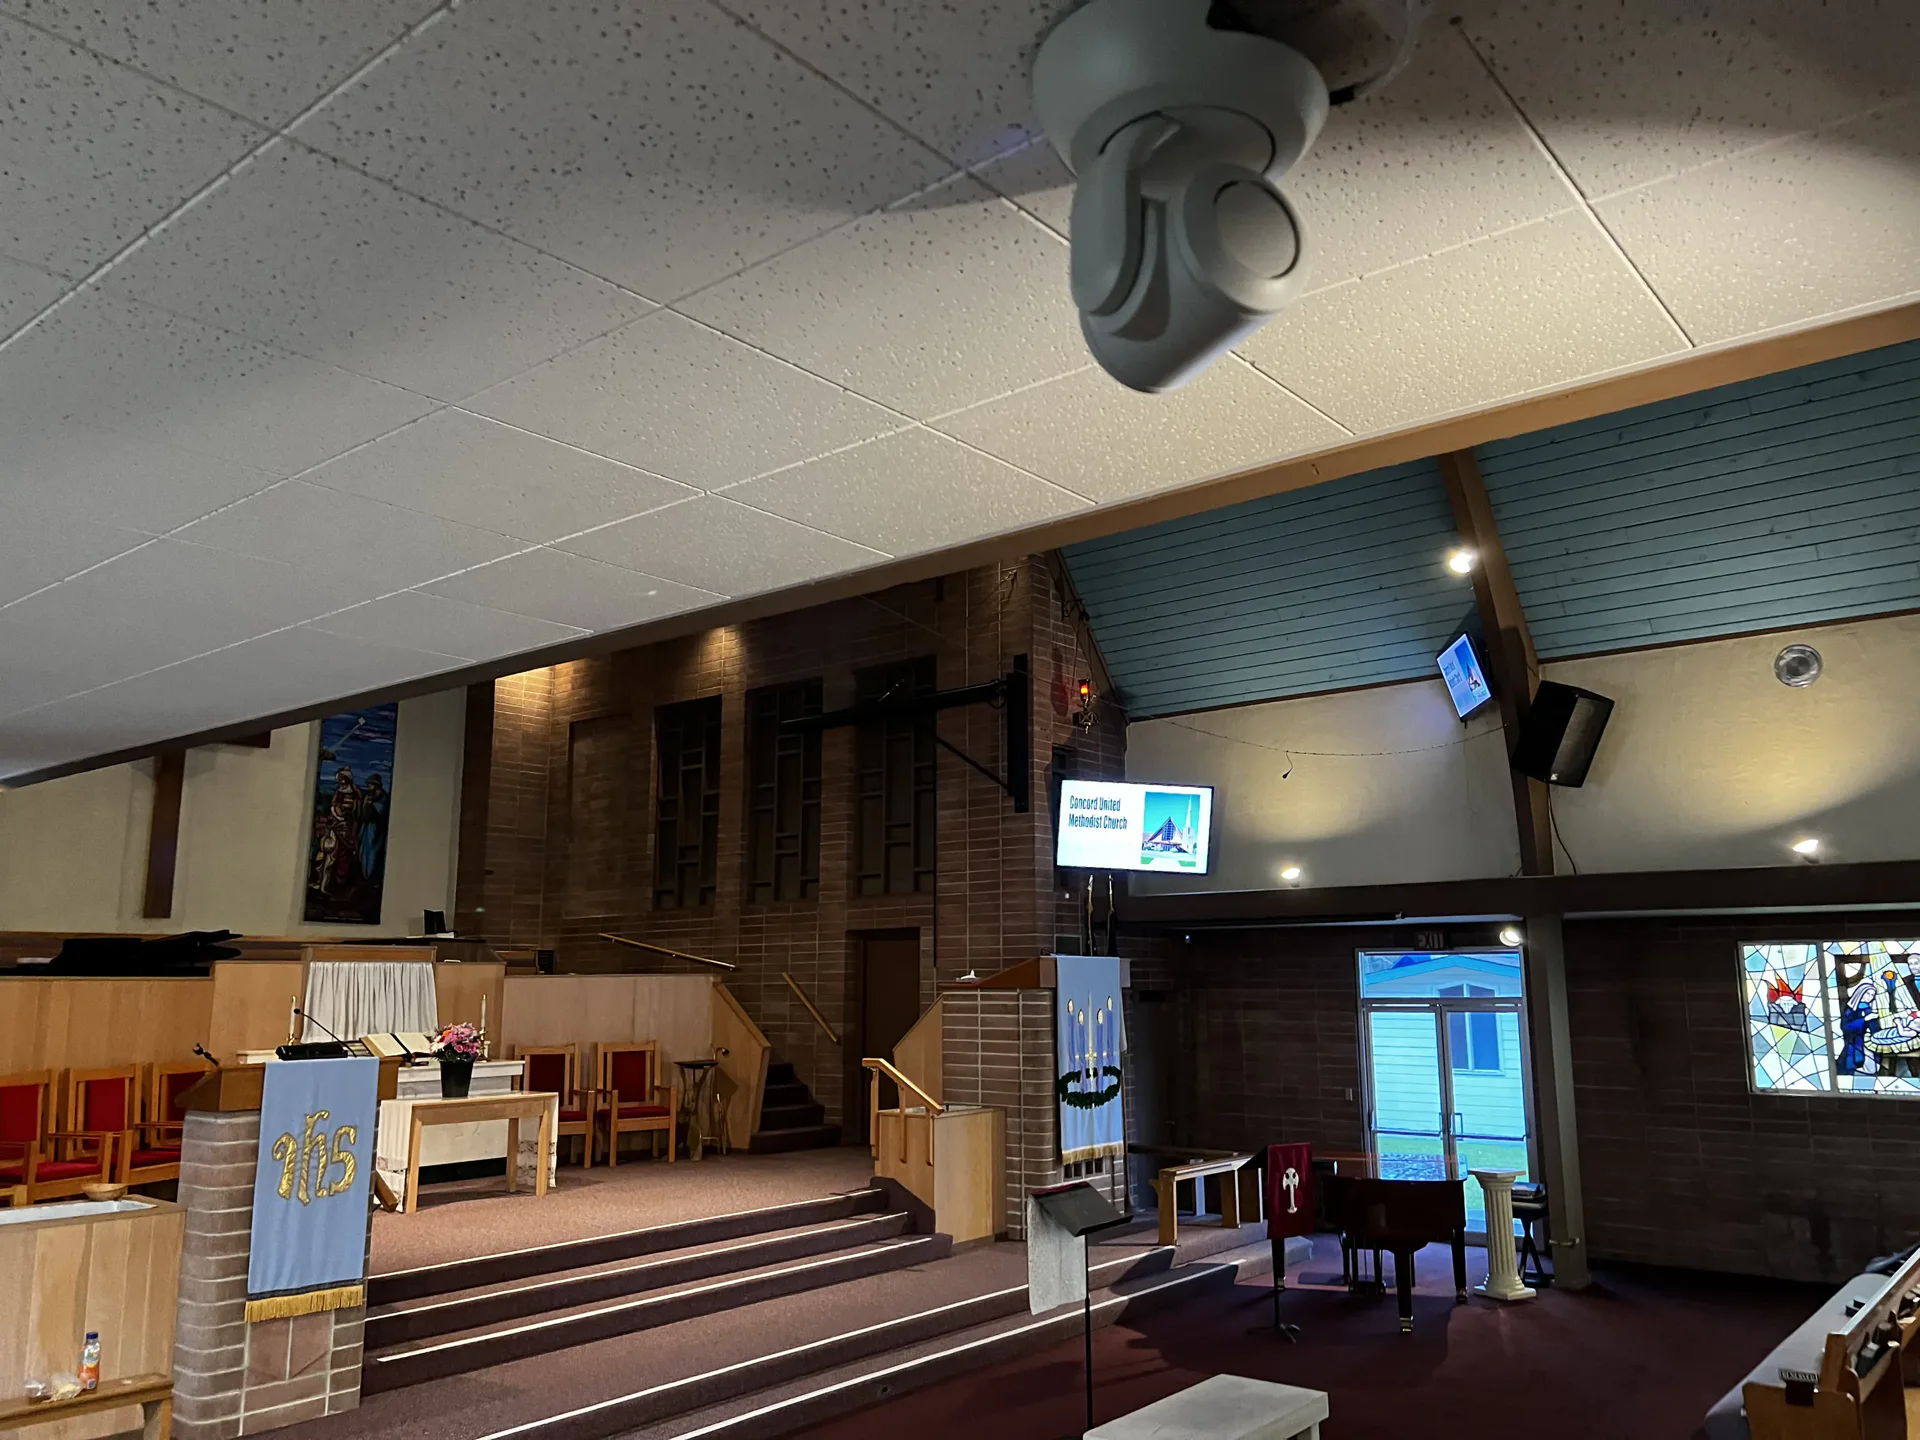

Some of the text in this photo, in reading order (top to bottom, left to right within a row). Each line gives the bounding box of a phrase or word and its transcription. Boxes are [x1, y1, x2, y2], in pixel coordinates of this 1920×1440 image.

[1070, 795, 1121, 811] Concord United
[1069, 813, 1127, 829] Methodist Church
